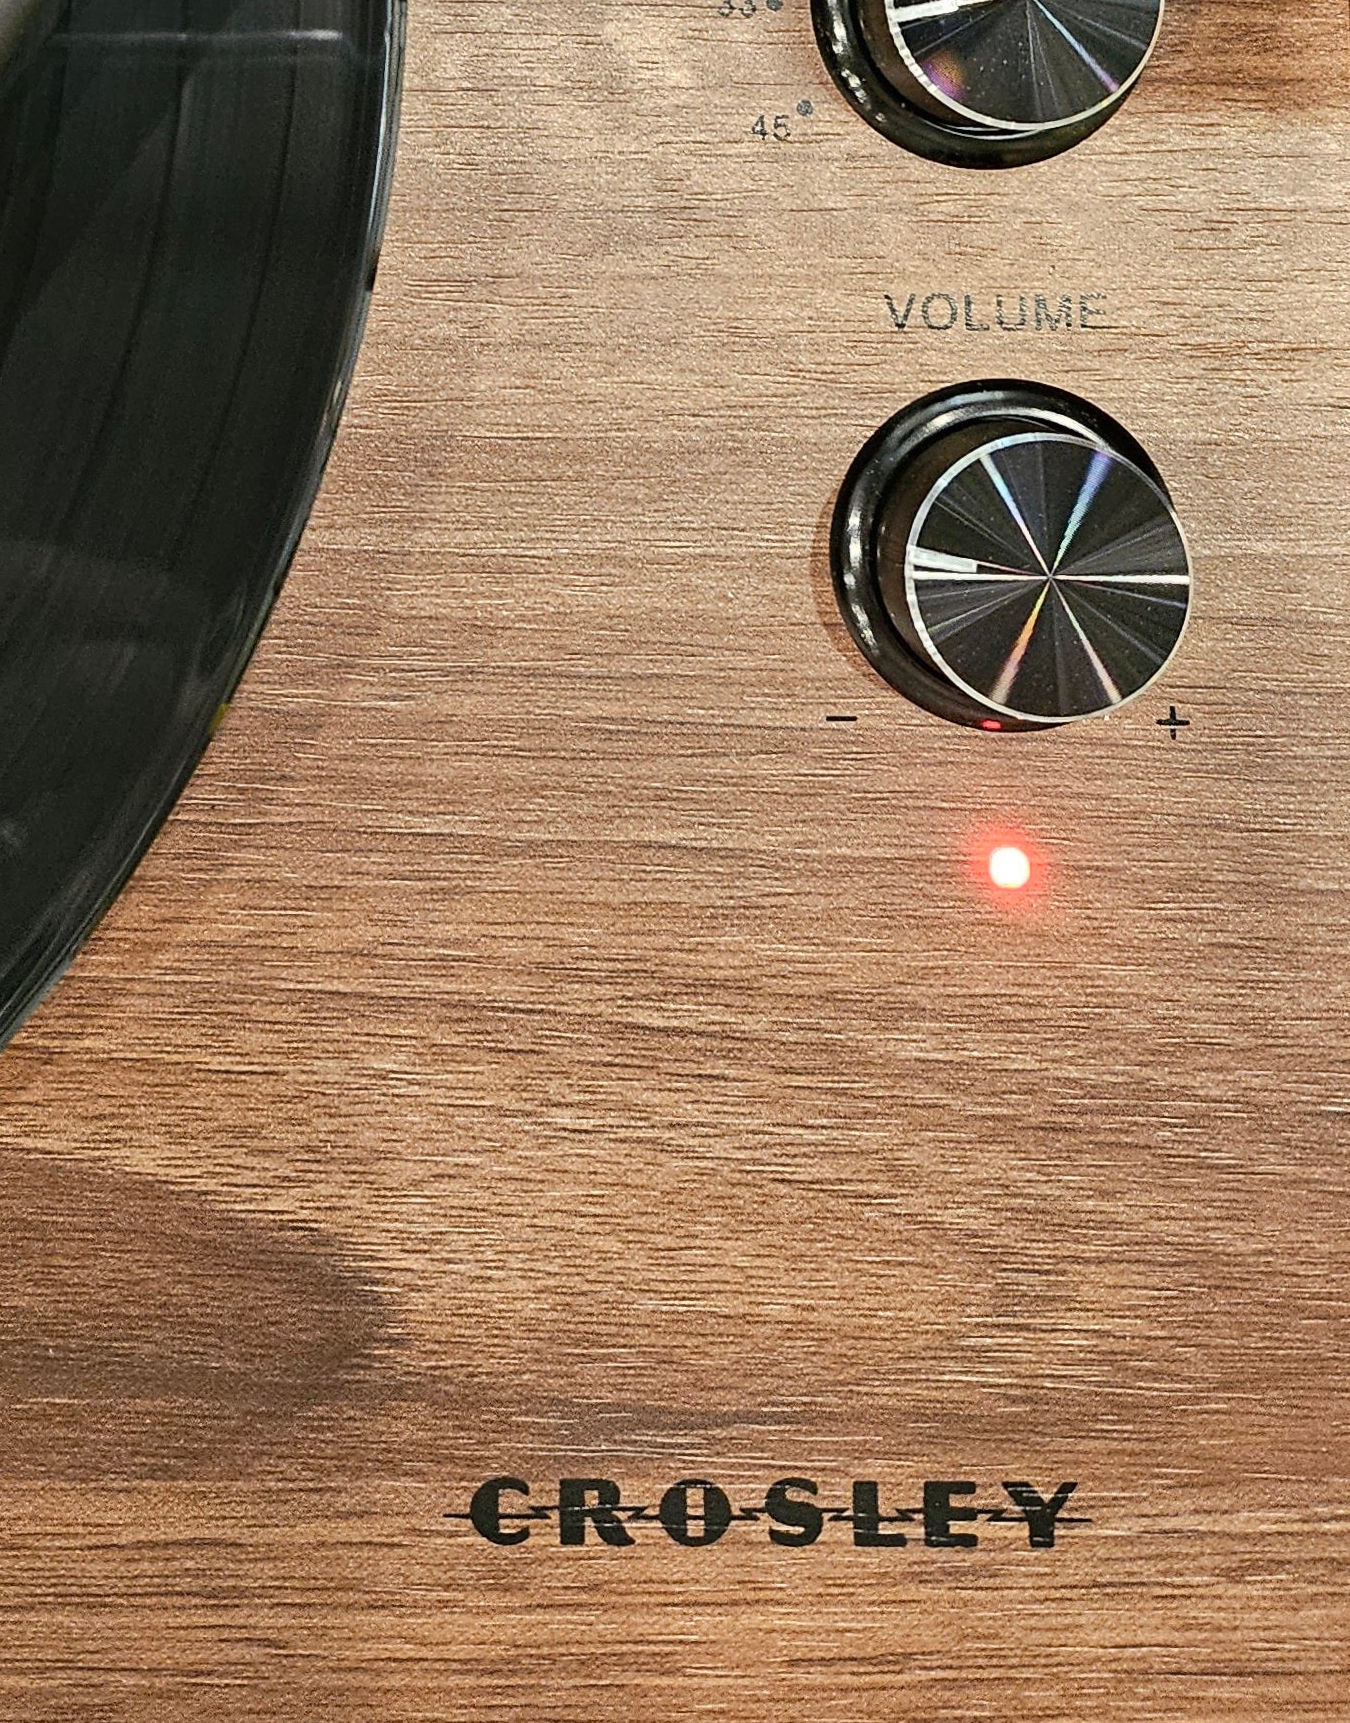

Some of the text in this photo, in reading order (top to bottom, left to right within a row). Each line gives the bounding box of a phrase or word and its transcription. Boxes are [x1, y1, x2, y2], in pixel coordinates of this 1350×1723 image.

[750, 114, 792, 142] 45
[883, 292, 1108, 332] VOLUME
[467, 1476, 1080, 1549] CROSLEY
